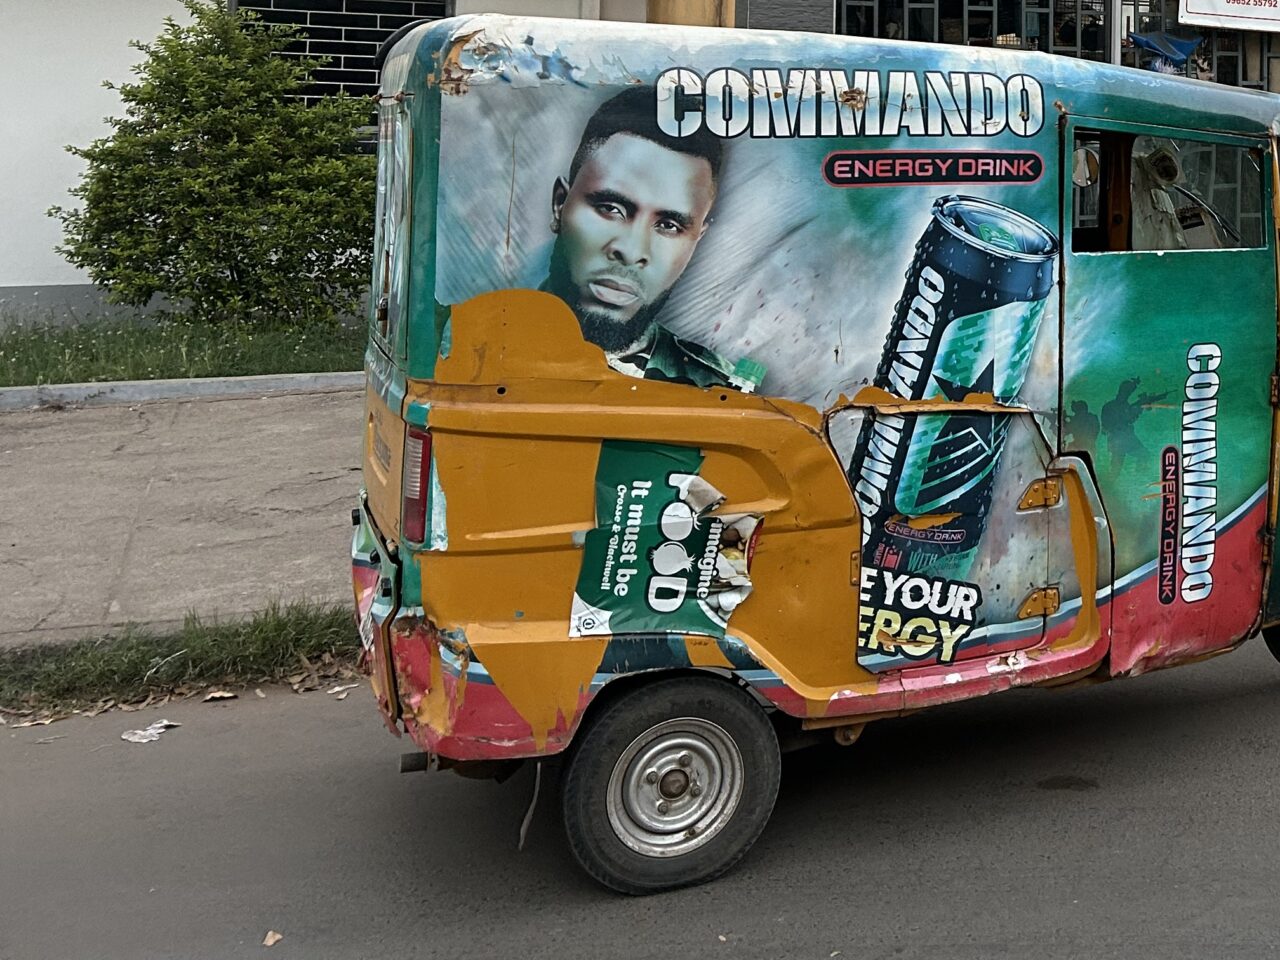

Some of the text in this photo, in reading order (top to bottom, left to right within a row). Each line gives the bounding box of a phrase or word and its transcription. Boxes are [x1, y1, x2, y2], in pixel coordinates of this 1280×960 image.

[656, 68, 1044, 139] COMMANDO
[833, 157, 1035, 178] ENERGY DRINK
[1180, 342, 1222, 604] COMMANDO
[613, 484, 628, 523] Crosse
[1161, 451, 1176, 599] ENERGY DRINK
[613, 480, 653, 597] It must be
[888, 522, 933, 539] ENERGY
[600, 535, 620, 591] Blackwell
[907, 551, 938, 572] WITH
[883, 570, 979, 621] YOUR
